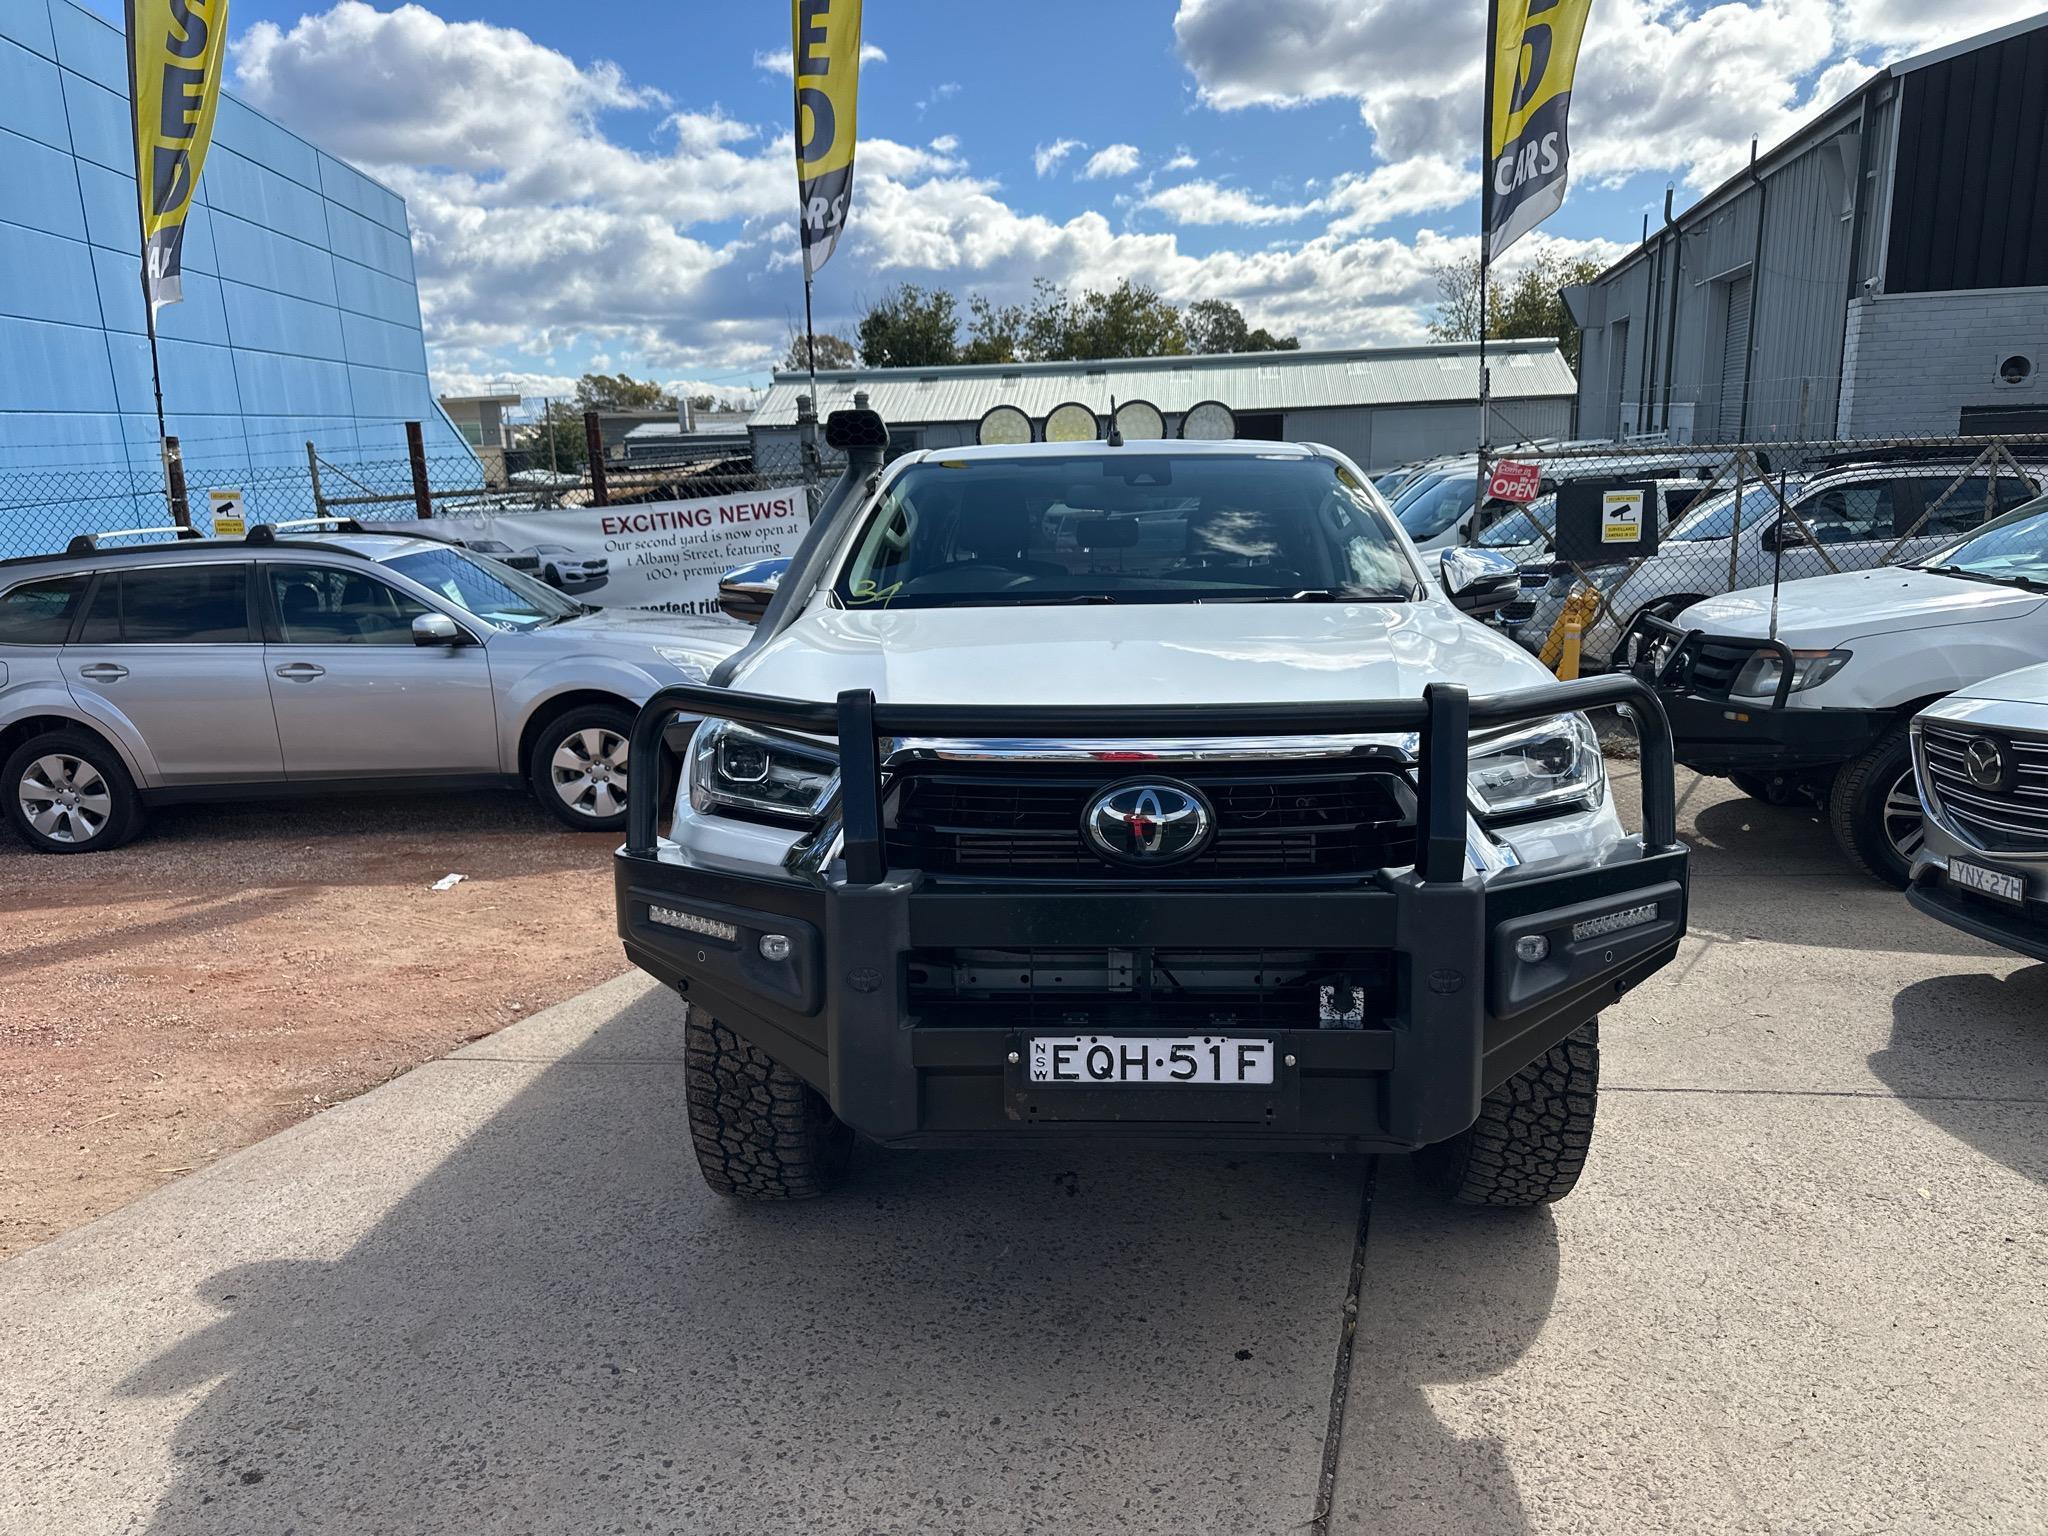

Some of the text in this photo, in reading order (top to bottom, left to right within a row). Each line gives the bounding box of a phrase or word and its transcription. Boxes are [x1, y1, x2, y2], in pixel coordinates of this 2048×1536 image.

[1494, 132, 1558, 196] CARS
[1493, 479, 1537, 498] OPEN
[601, 498, 795, 535] EXCITING NEWS!
[604, 523, 799, 552] Our second yard is now open at
[635, 552, 680, 567] Albany
[683, 548, 723, 561] Street,
[726, 541, 782, 556] featuring
[646, 567, 678, 581] 100+
[640, 601, 696, 615] rfect
